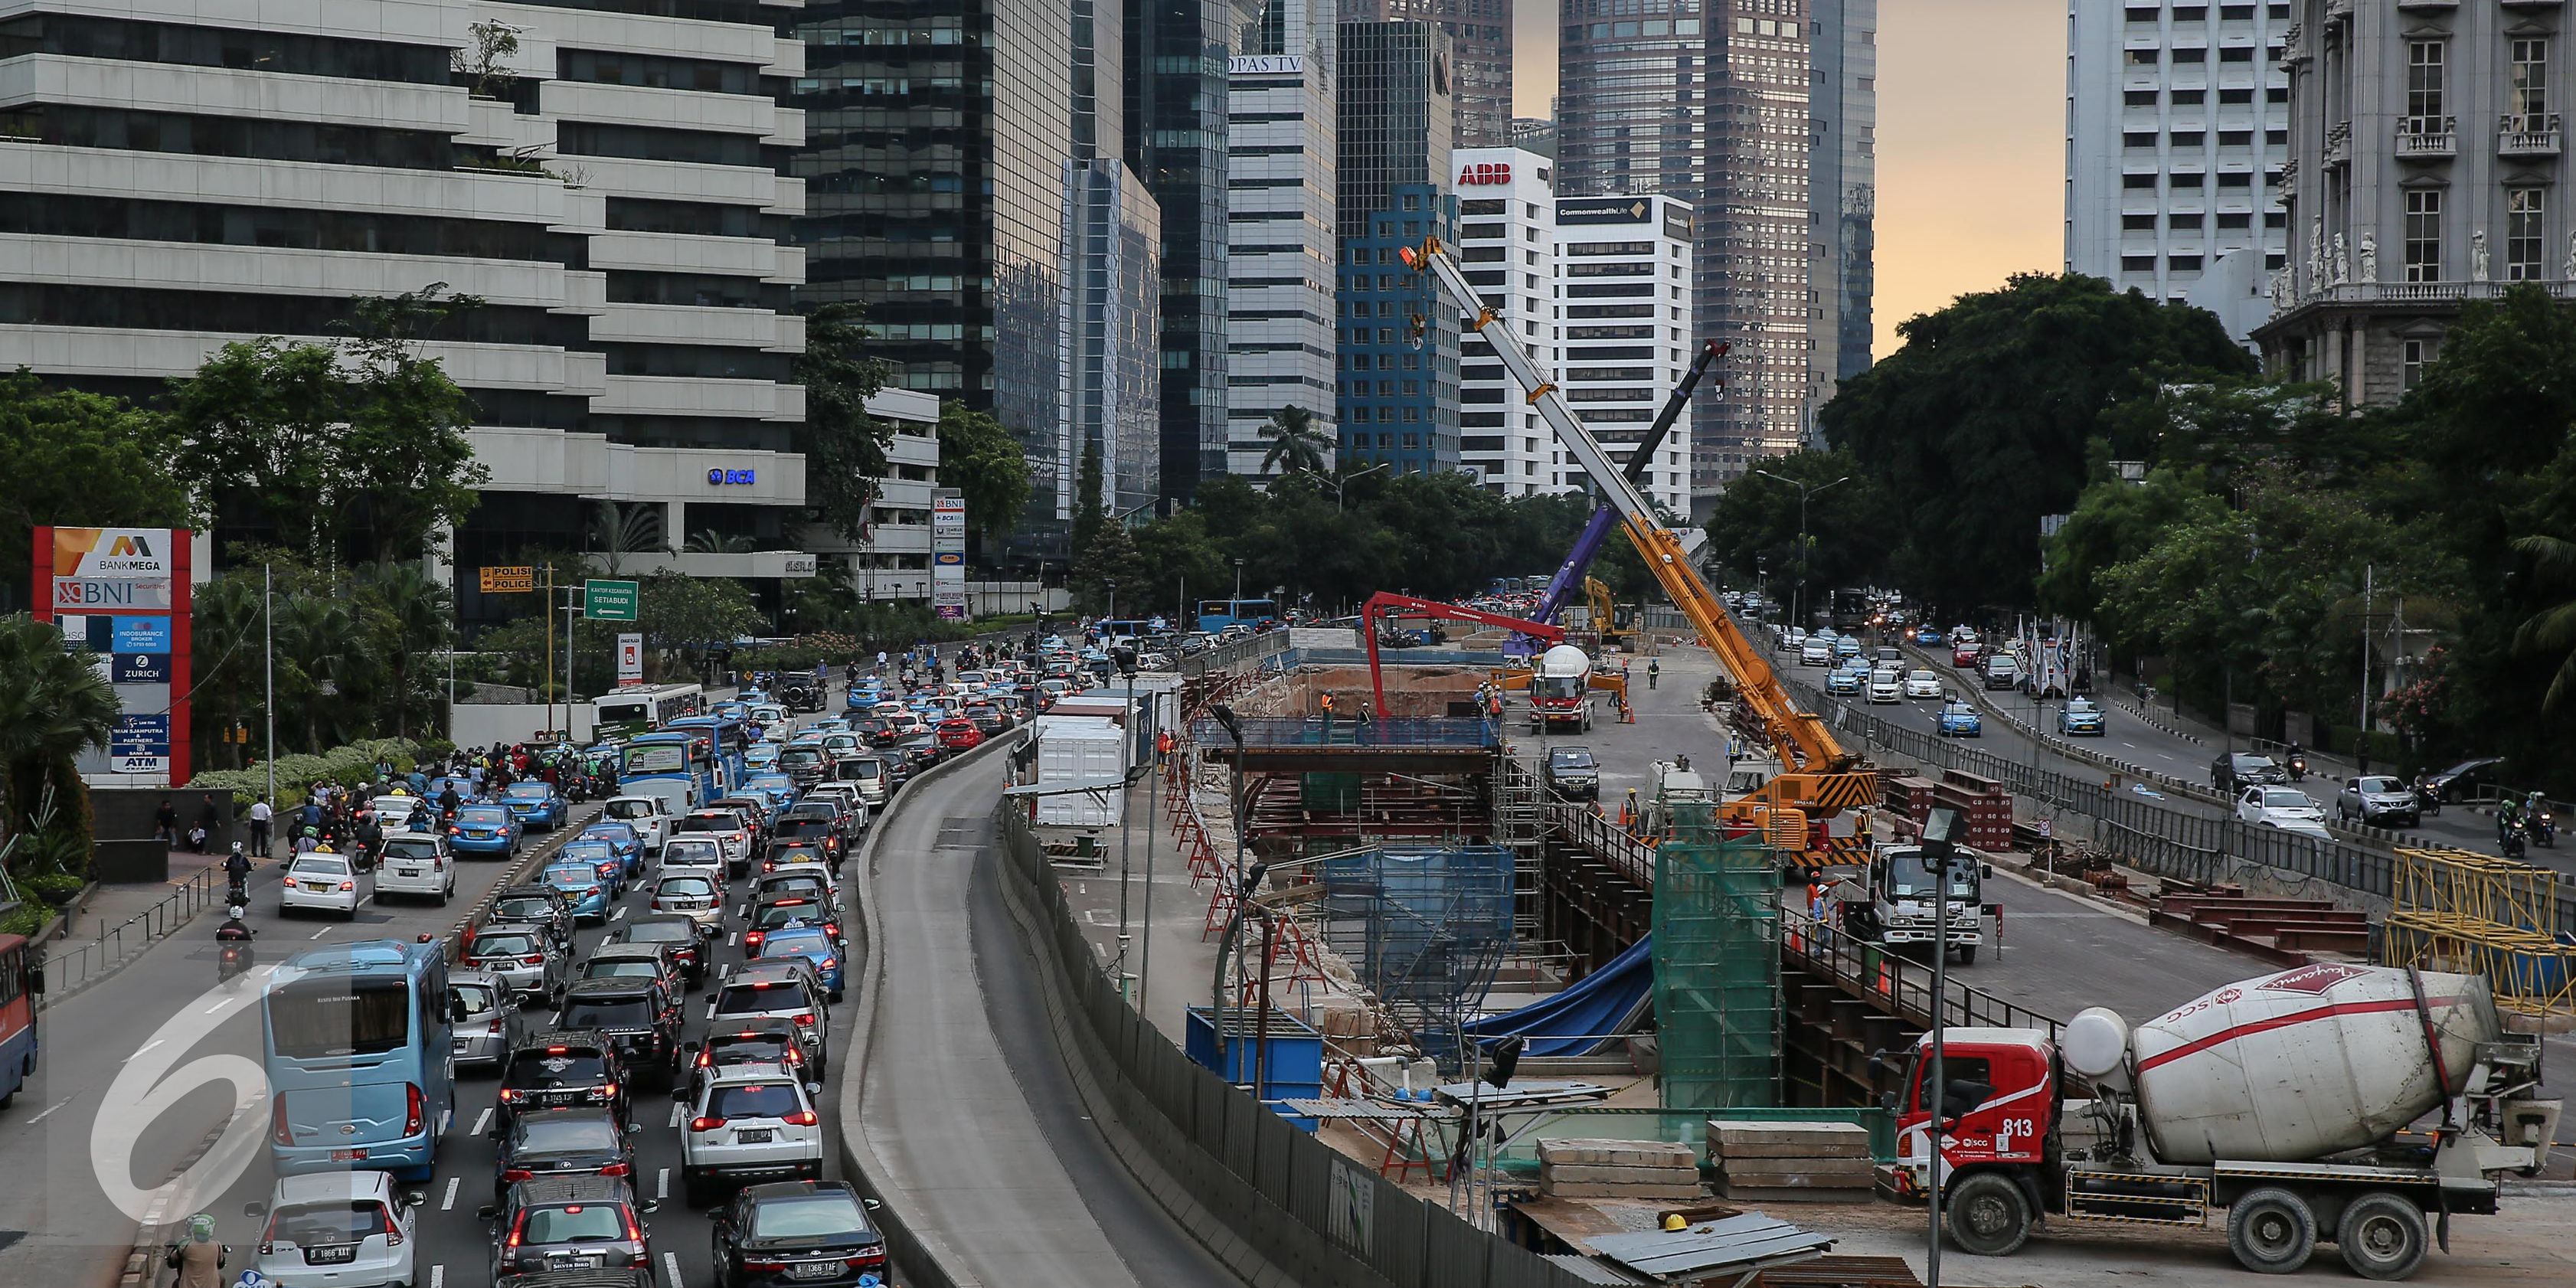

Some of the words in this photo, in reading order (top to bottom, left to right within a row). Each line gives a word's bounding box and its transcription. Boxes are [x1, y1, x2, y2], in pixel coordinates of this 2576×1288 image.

[1275, 57, 1301, 71] TV
[1458, 164, 1511, 185] ABB
[1560, 208, 1628, 216] CommonwealthLife
[724, 469, 754, 485] BCA
[494, 567, 531, 576] POLISI
[495, 580, 531, 588] POLICE
[85, 582, 132, 603] BNI
[593, 596, 629, 604] SETIABUDI
[125, 758, 157, 767] ATM
[2166, 999, 2208, 1023] SCG
[2002, 1118, 2033, 1137] 813
[311, 1250, 315, 1258] D
[796, 1265, 802, 1273] B
[808, 1264, 822, 1273] 1366
[825, 1262, 836, 1271] TAF
